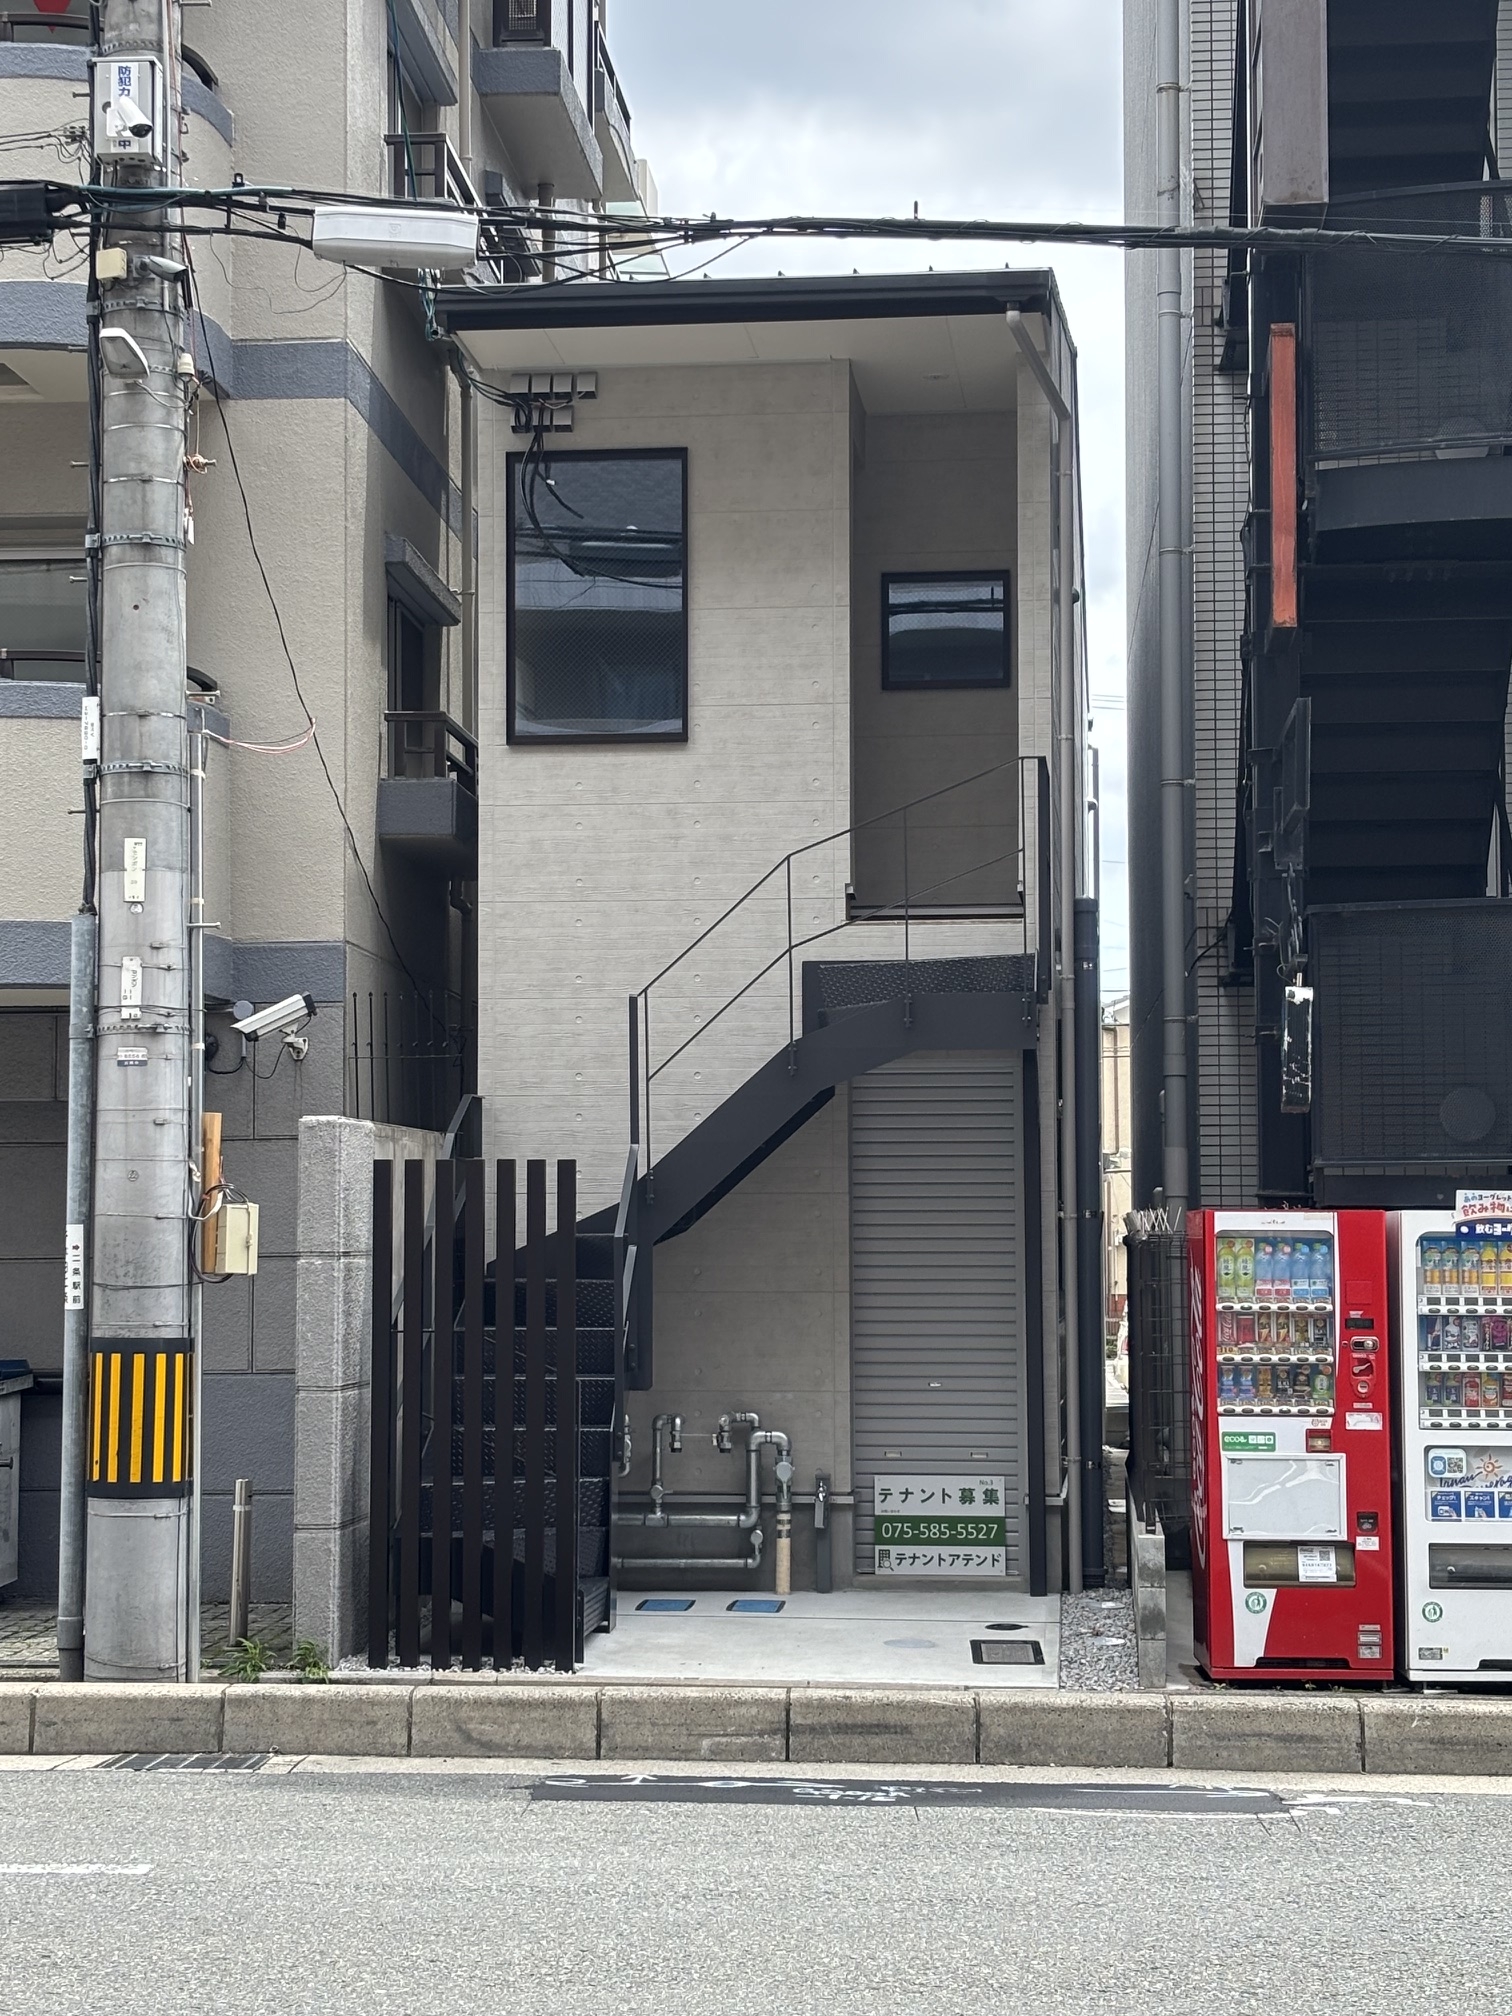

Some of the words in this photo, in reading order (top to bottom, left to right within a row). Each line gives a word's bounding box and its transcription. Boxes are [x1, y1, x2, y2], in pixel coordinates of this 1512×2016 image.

[72, 1254, 81, 1304] 二条駅前
[878, 1487, 1000, 1506] テナント募集
[882, 1523, 998, 1539] 075-585-5527
[894, 1552, 1002, 1568] テナントアテンド
